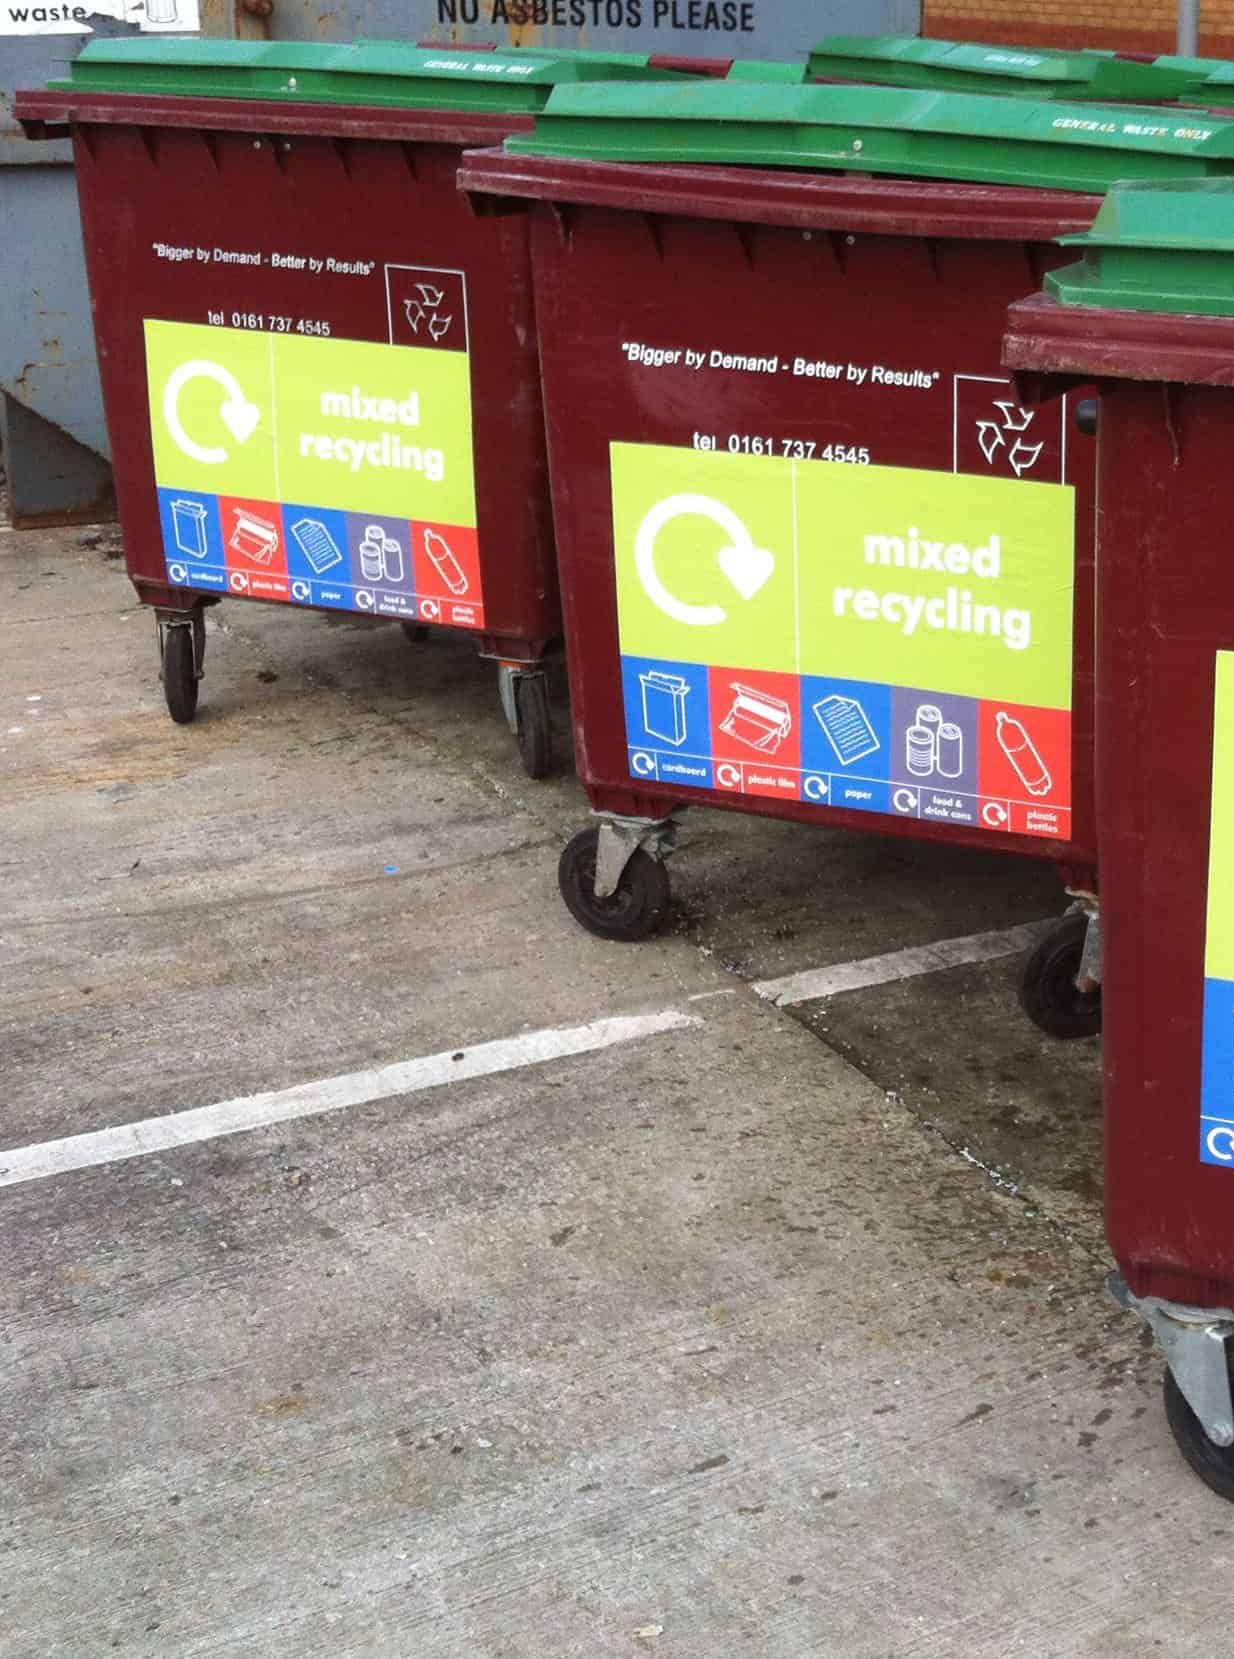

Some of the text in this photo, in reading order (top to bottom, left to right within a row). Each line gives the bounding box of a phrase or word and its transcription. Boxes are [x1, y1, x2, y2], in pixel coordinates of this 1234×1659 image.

[8, 3, 87, 23] waste
[437, 0, 756, 32] NO ASBESTOS PLEASE
[1052, 118, 1117, 133] GENERAL
[1174, 128, 1213, 141] ONLY
[152, 243, 194, 261] "Bigger
[196, 248, 210, 263] by
[213, 248, 261, 265] Demand
[271, 253, 305, 269] Better
[309, 257, 323, 273] by
[326, 258, 375, 275] Results"
[208, 310, 331, 336] tel 0161 737 4545
[621, 343, 681, 366] "Bigger
[685, 349, 705, 369] by
[710, 350, 778, 374] Demand
[793, 358, 843, 380] Better
[847, 364, 866, 385] by
[871, 365, 940, 389] Results"
[319, 385, 420, 426] mixed
[299, 432, 446, 481] recycling
[693, 431, 871, 466] tel 0161 737 4545
[863, 526, 1001, 578] mixed
[832, 586, 1032, 650] recycling
[661, 763, 707, 777] cardboard
[845, 789, 872, 801] paper
[933, 795, 953, 807] food
[924, 805, 972, 821] drink cans
[1027, 810, 1058, 823] plastic
[1026, 821, 1058, 833] bottles
